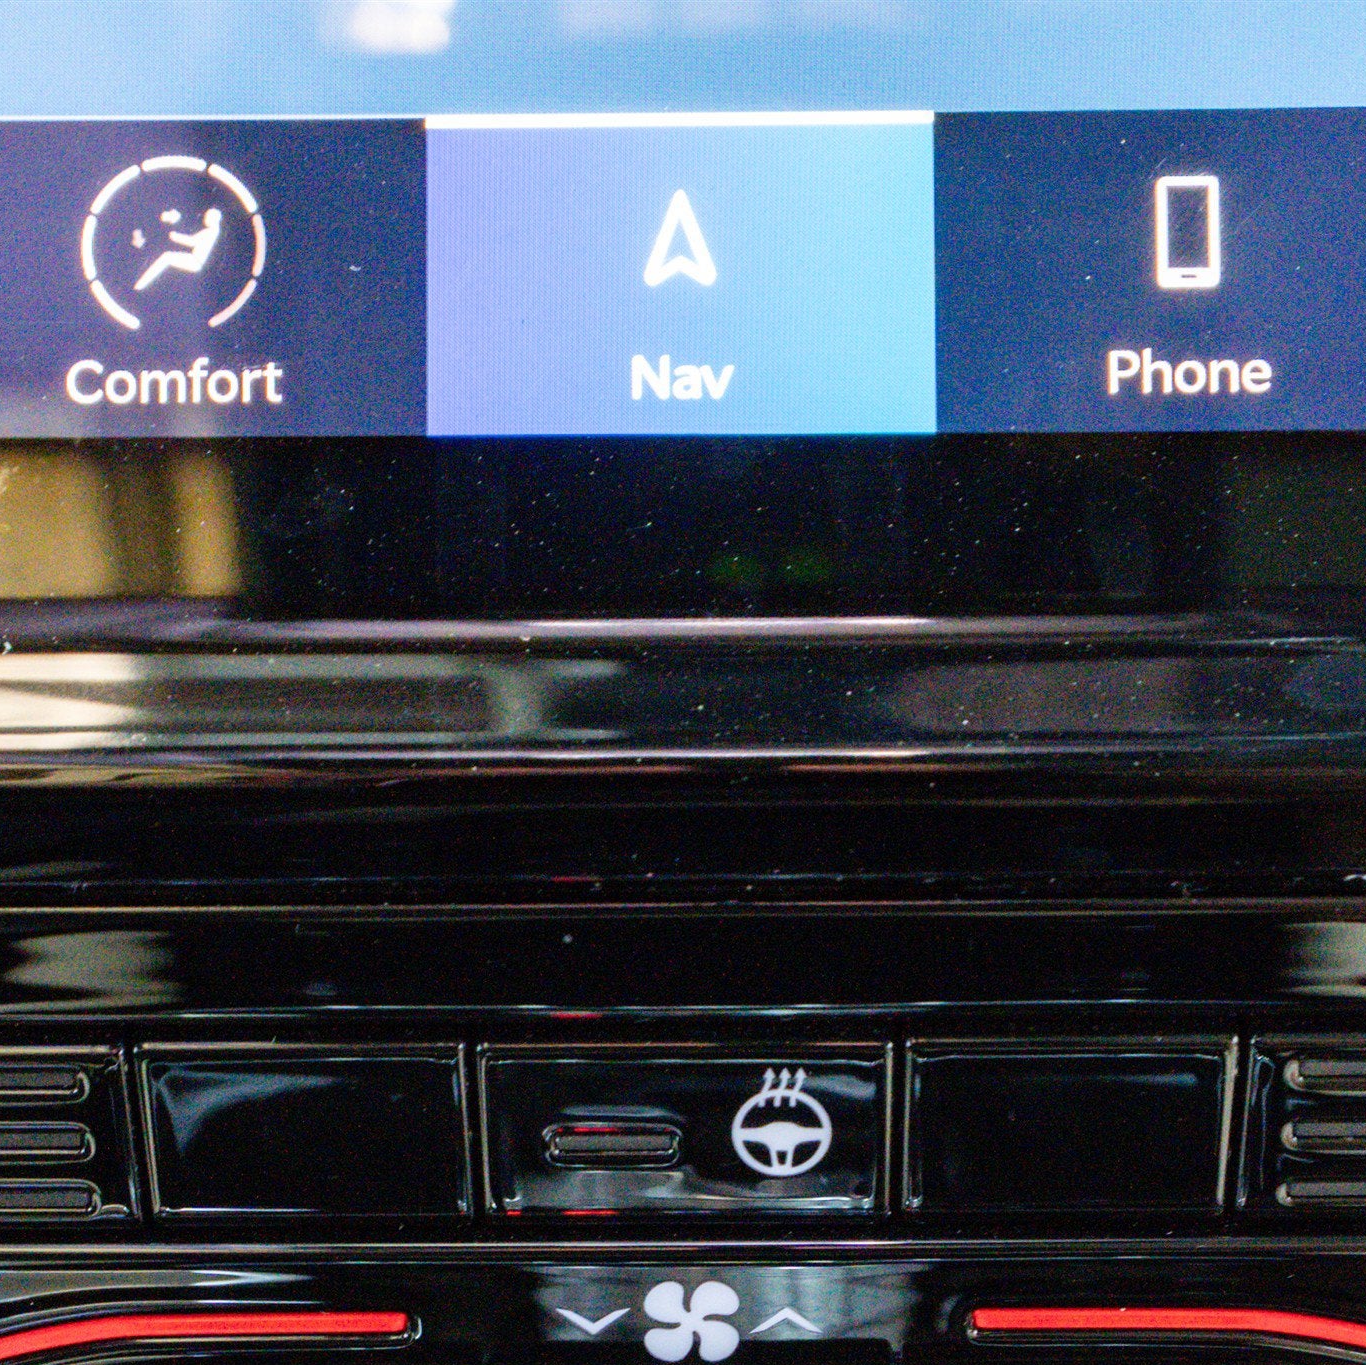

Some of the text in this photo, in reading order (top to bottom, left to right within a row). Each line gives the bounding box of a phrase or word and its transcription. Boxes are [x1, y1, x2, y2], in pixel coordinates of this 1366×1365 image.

[65, 356, 283, 406] Comfort
[630, 353, 735, 402] Nav
[1107, 346, 1274, 397] Phone
